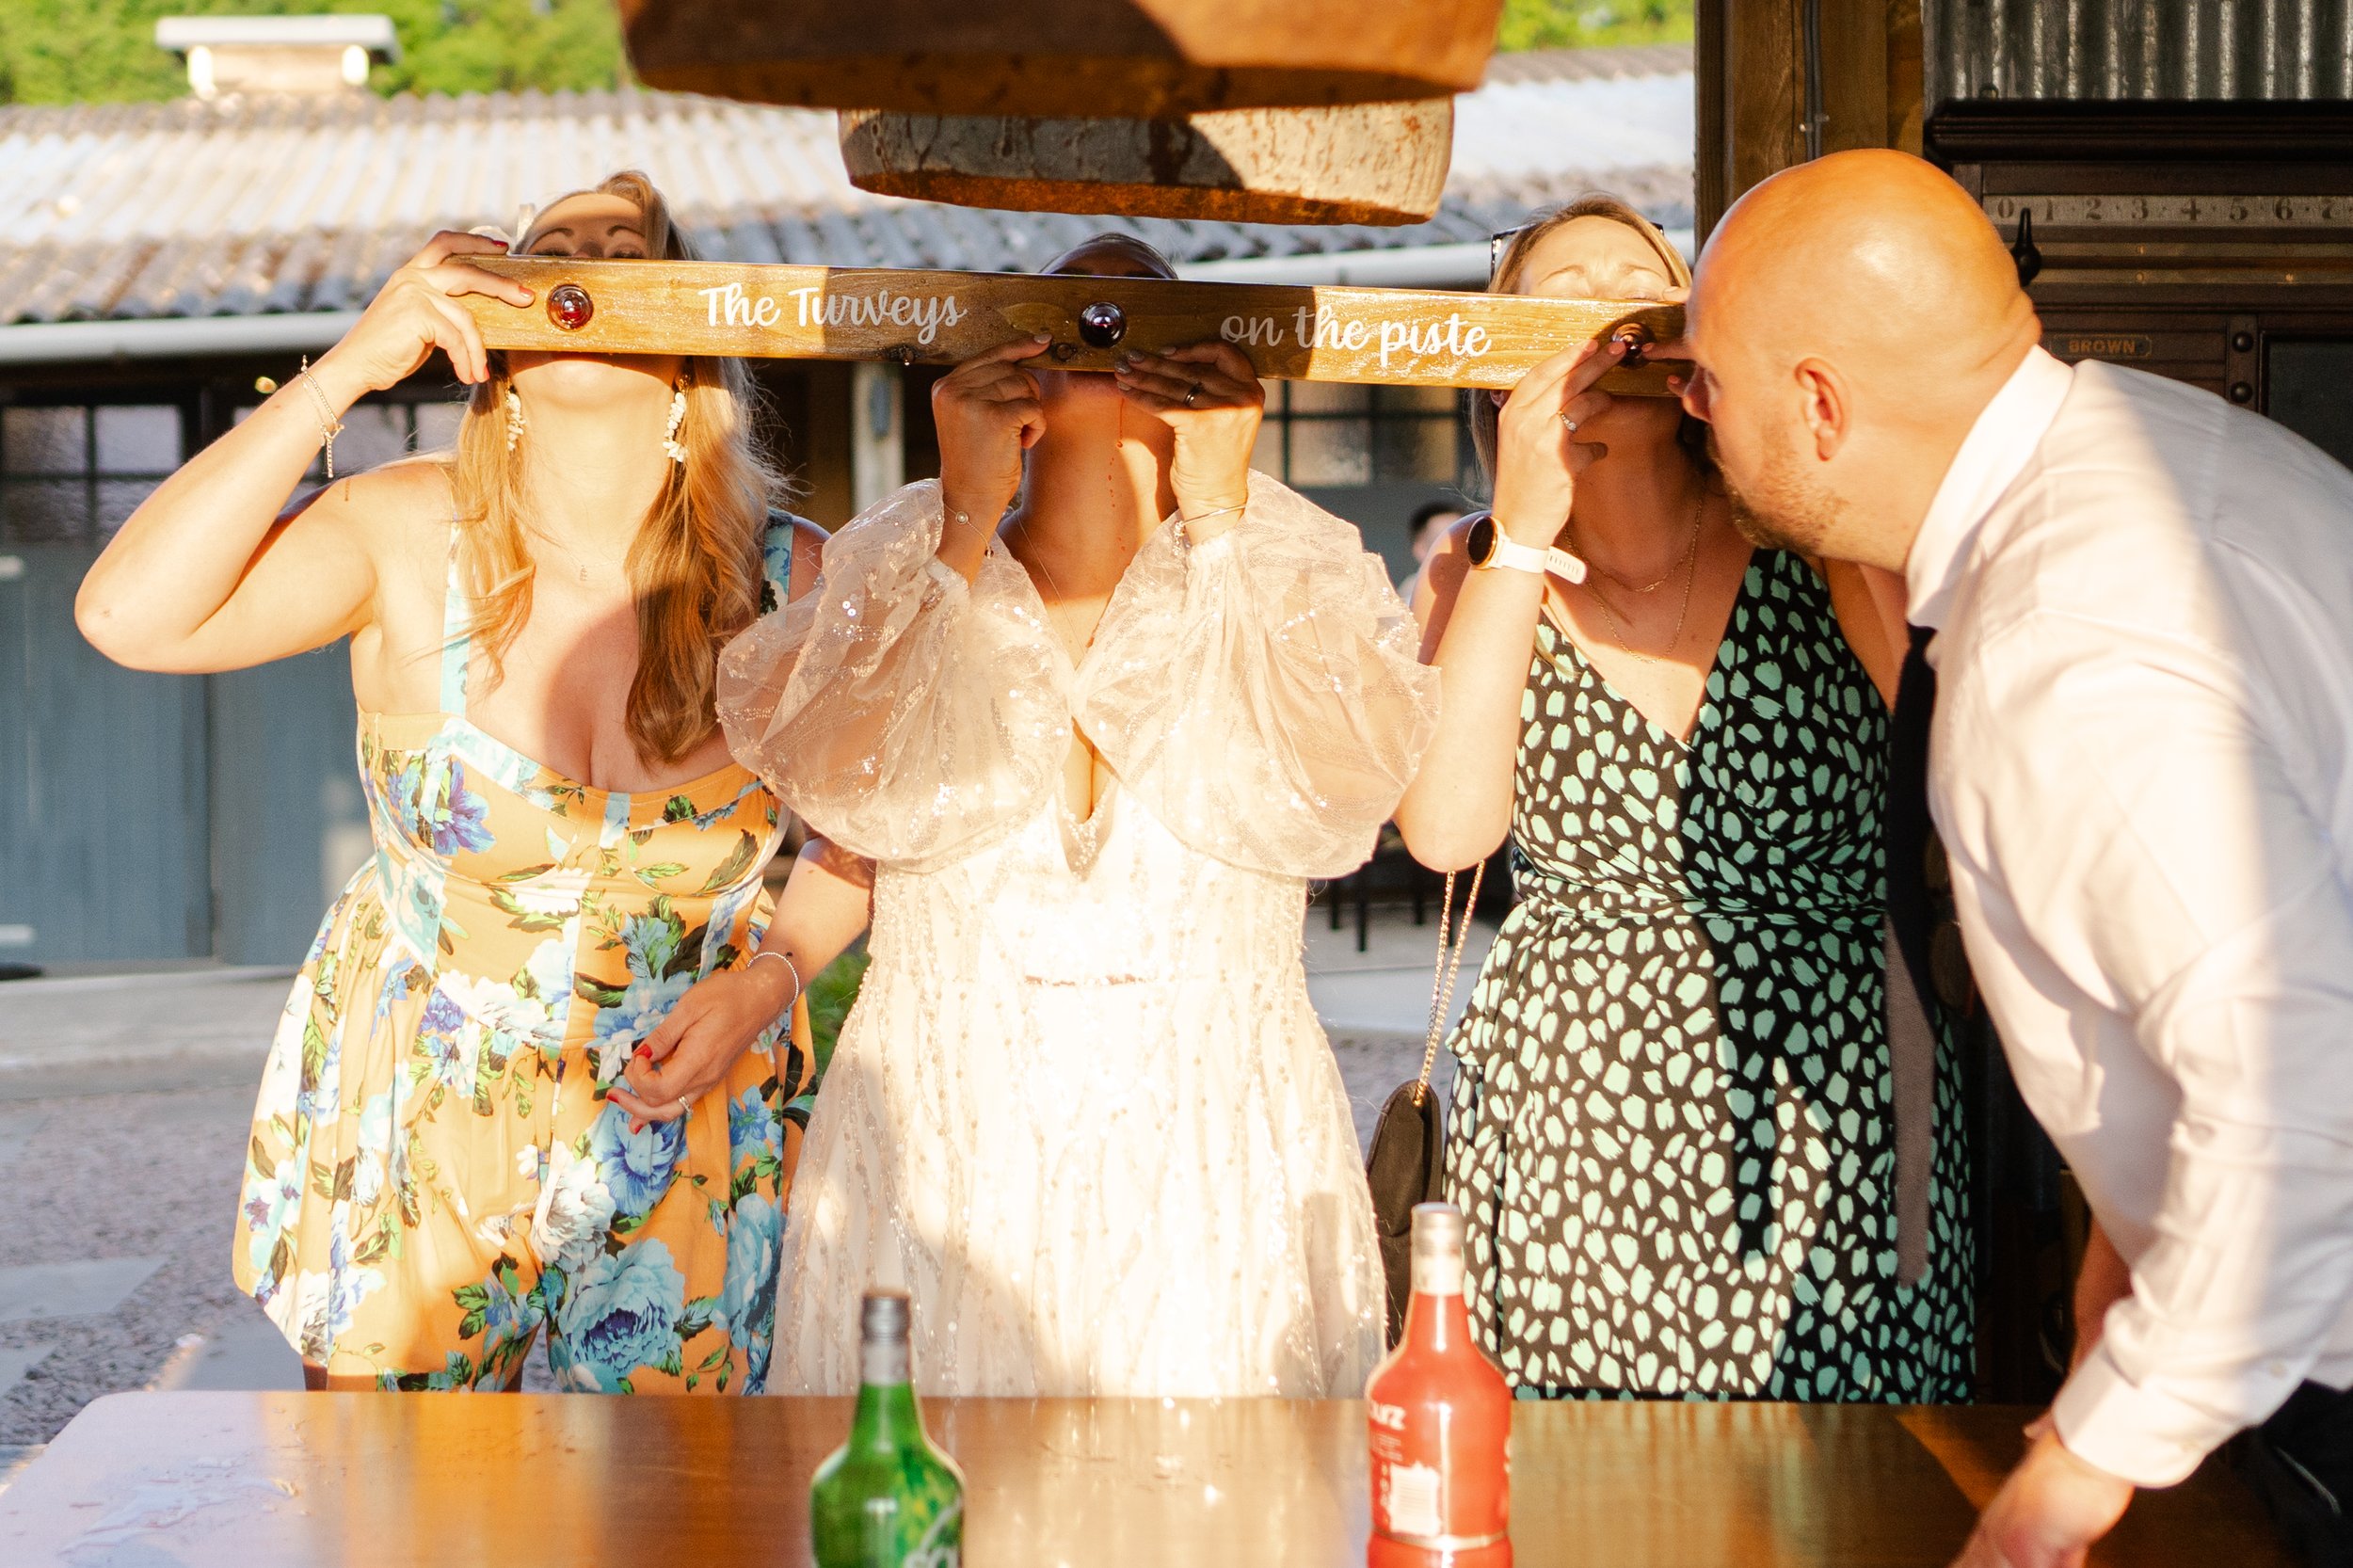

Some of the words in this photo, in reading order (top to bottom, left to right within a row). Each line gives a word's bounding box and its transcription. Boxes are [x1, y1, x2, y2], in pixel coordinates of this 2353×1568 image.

[1996, 197, 2015, 219] 0
[2045, 198, 2055, 221] 1
[2086, 197, 2103, 221] 2
[2131, 197, 2150, 220] 3
[2181, 197, 2201, 221] 4
[2230, 196, 2249, 221] 5
[2274, 197, 2294, 221] 6
[2320, 196, 2336, 220] 7
[697, 281, 781, 328] The
[788, 285, 968, 345] Turveys
[1220, 313, 1284, 346] on
[1291, 304, 1376, 351] the
[1377, 312, 1492, 368] piste
[2068, 339, 2137, 355] BROWN
